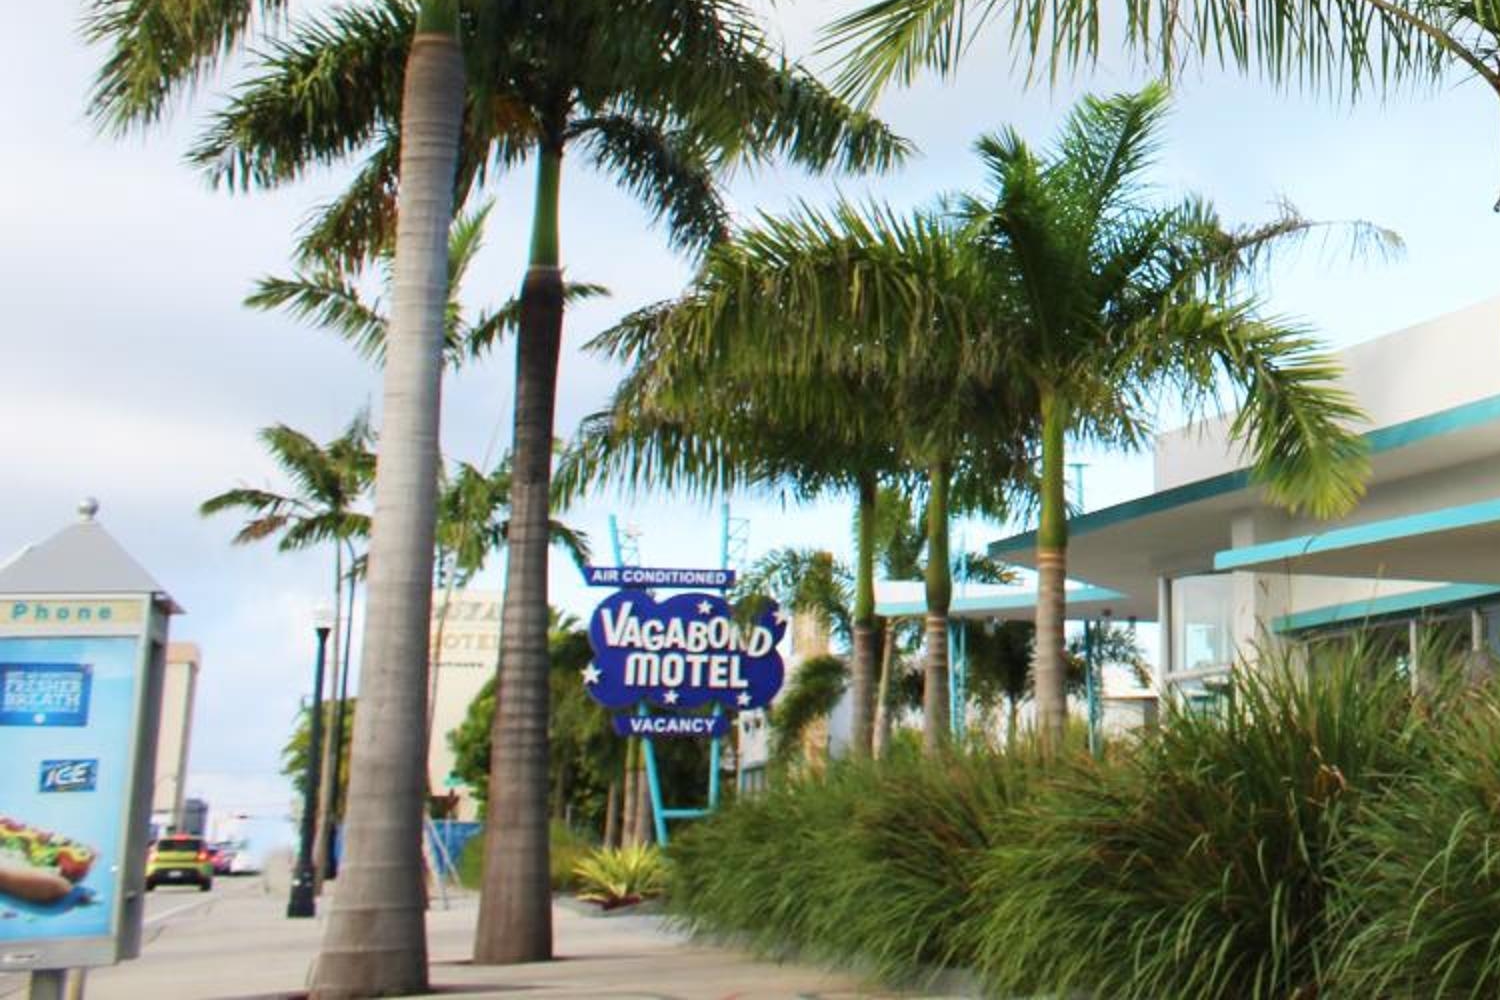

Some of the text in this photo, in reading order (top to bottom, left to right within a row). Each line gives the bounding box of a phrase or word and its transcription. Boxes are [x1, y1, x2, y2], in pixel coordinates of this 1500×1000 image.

[591, 570, 727, 585] AIR CONDITIONED
[11, 603, 112, 621] Phone
[624, 653, 749, 689] MOTEL
[630, 717, 718, 733] VACANCY
[46, 763, 90, 786] ICE
